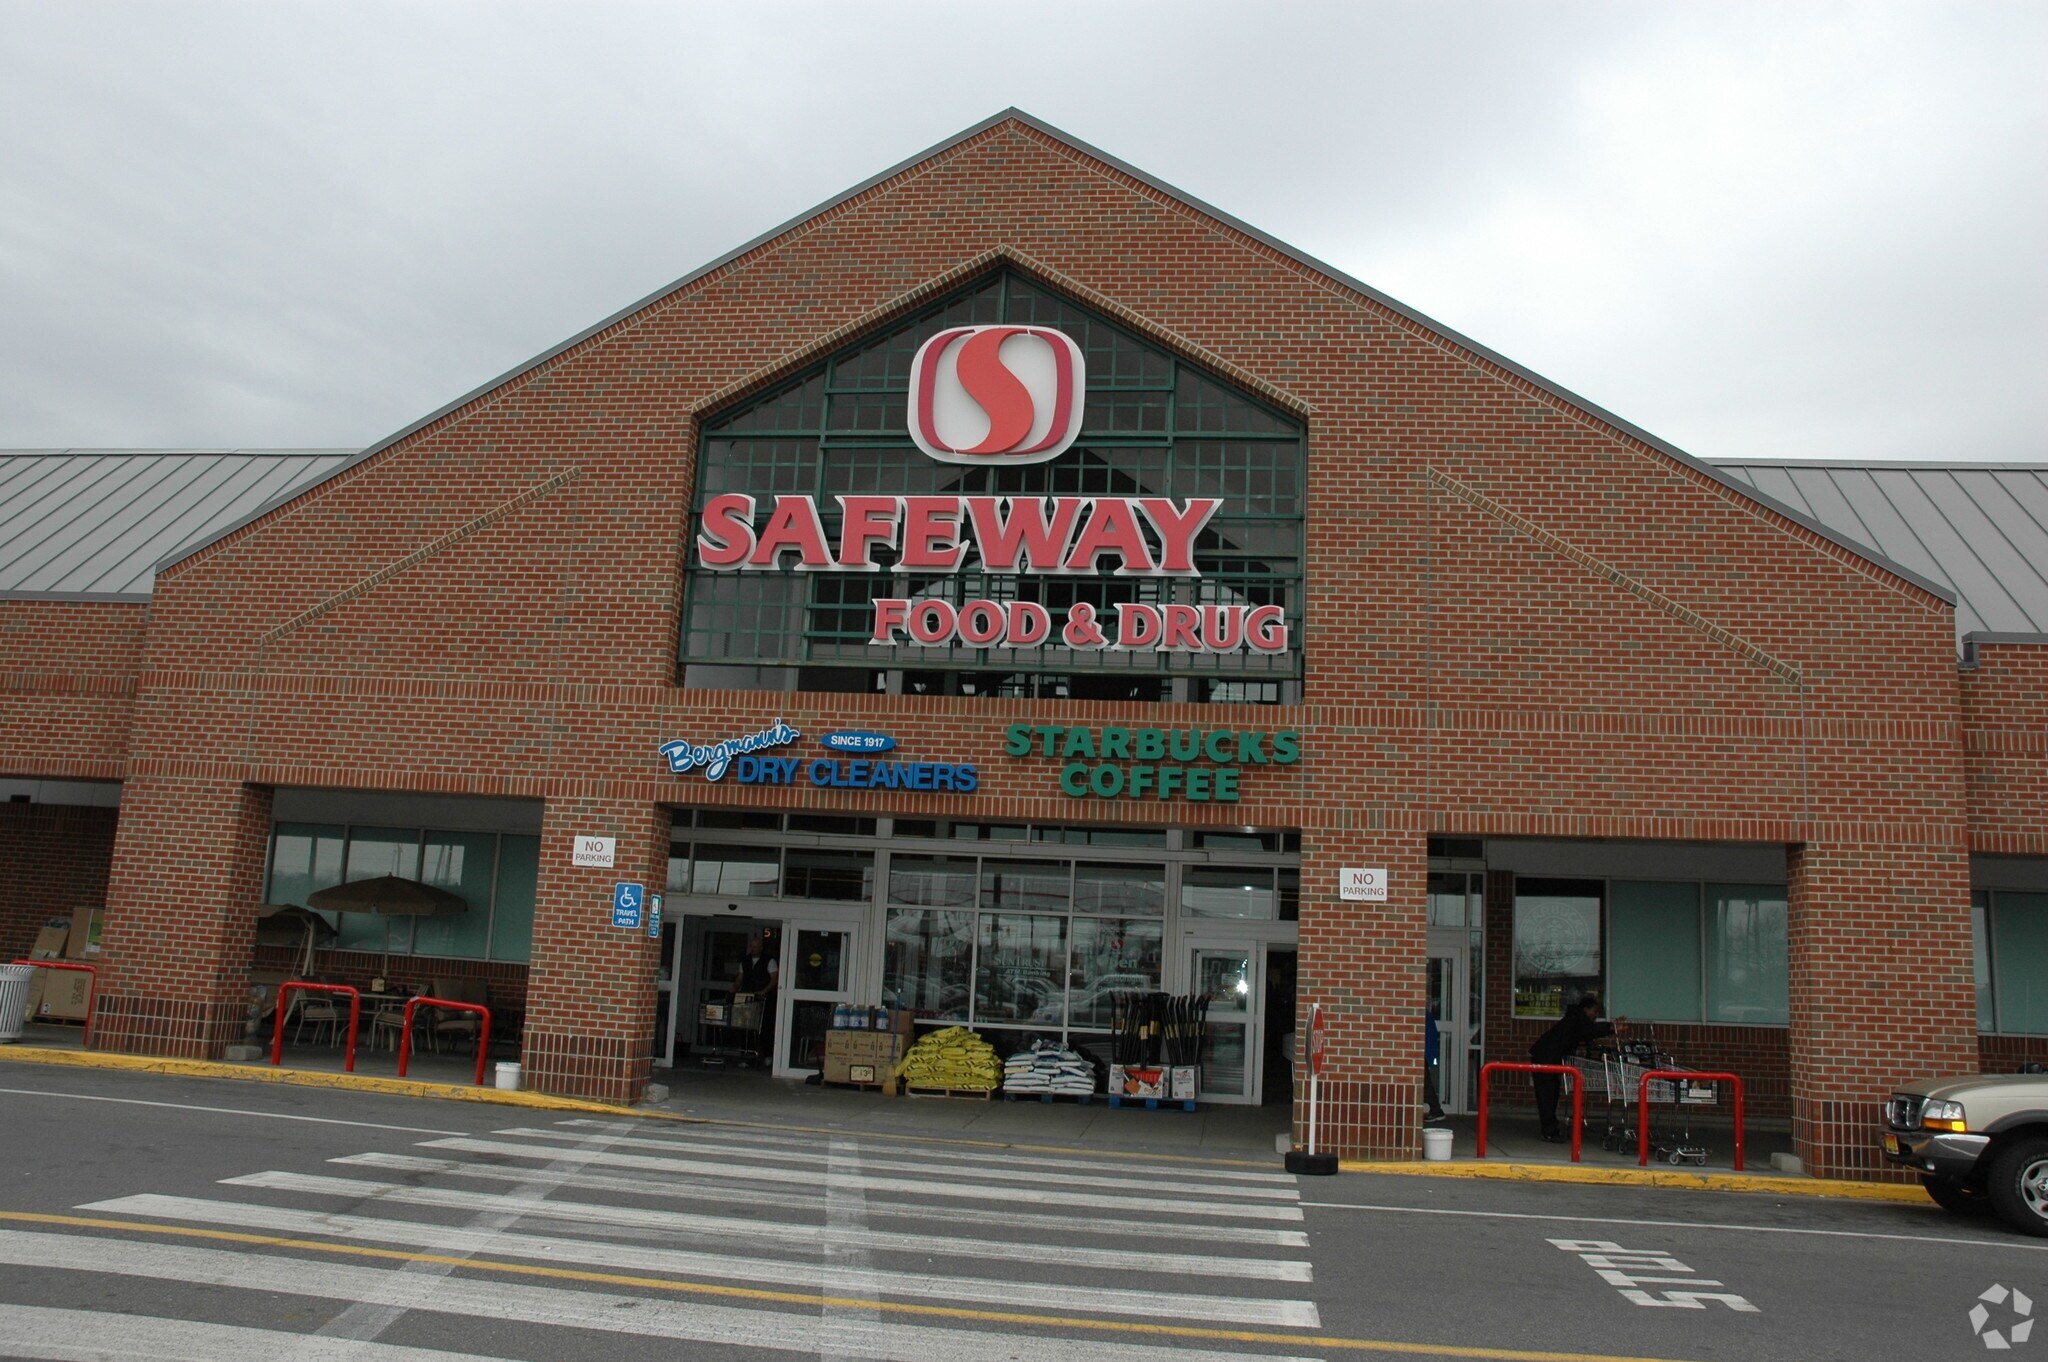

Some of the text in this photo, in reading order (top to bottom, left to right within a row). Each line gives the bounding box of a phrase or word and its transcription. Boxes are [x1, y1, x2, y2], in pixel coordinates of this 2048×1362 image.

[697, 493, 1223, 577] SAFEWAY
[869, 598, 1288, 655] FOOD & DRUG
[659, 717, 800, 782] Bergmann's
[831, 735, 885, 748] SINCE 1917
[1004, 723, 1300, 764] STARBUCKS
[737, 756, 978, 792] DRY CLEANERS
[1059, 762, 1241, 802] COFFEE
[575, 853, 612, 863] PARKING
[585, 841, 604, 852] NO
[1353, 873, 1374, 885] NO
[1343, 887, 1385, 896] PARKING
[616, 909, 638, 917] TRAVEL
[617, 918, 635, 926] PATH
[1545, 1238, 1762, 1313] STOP
